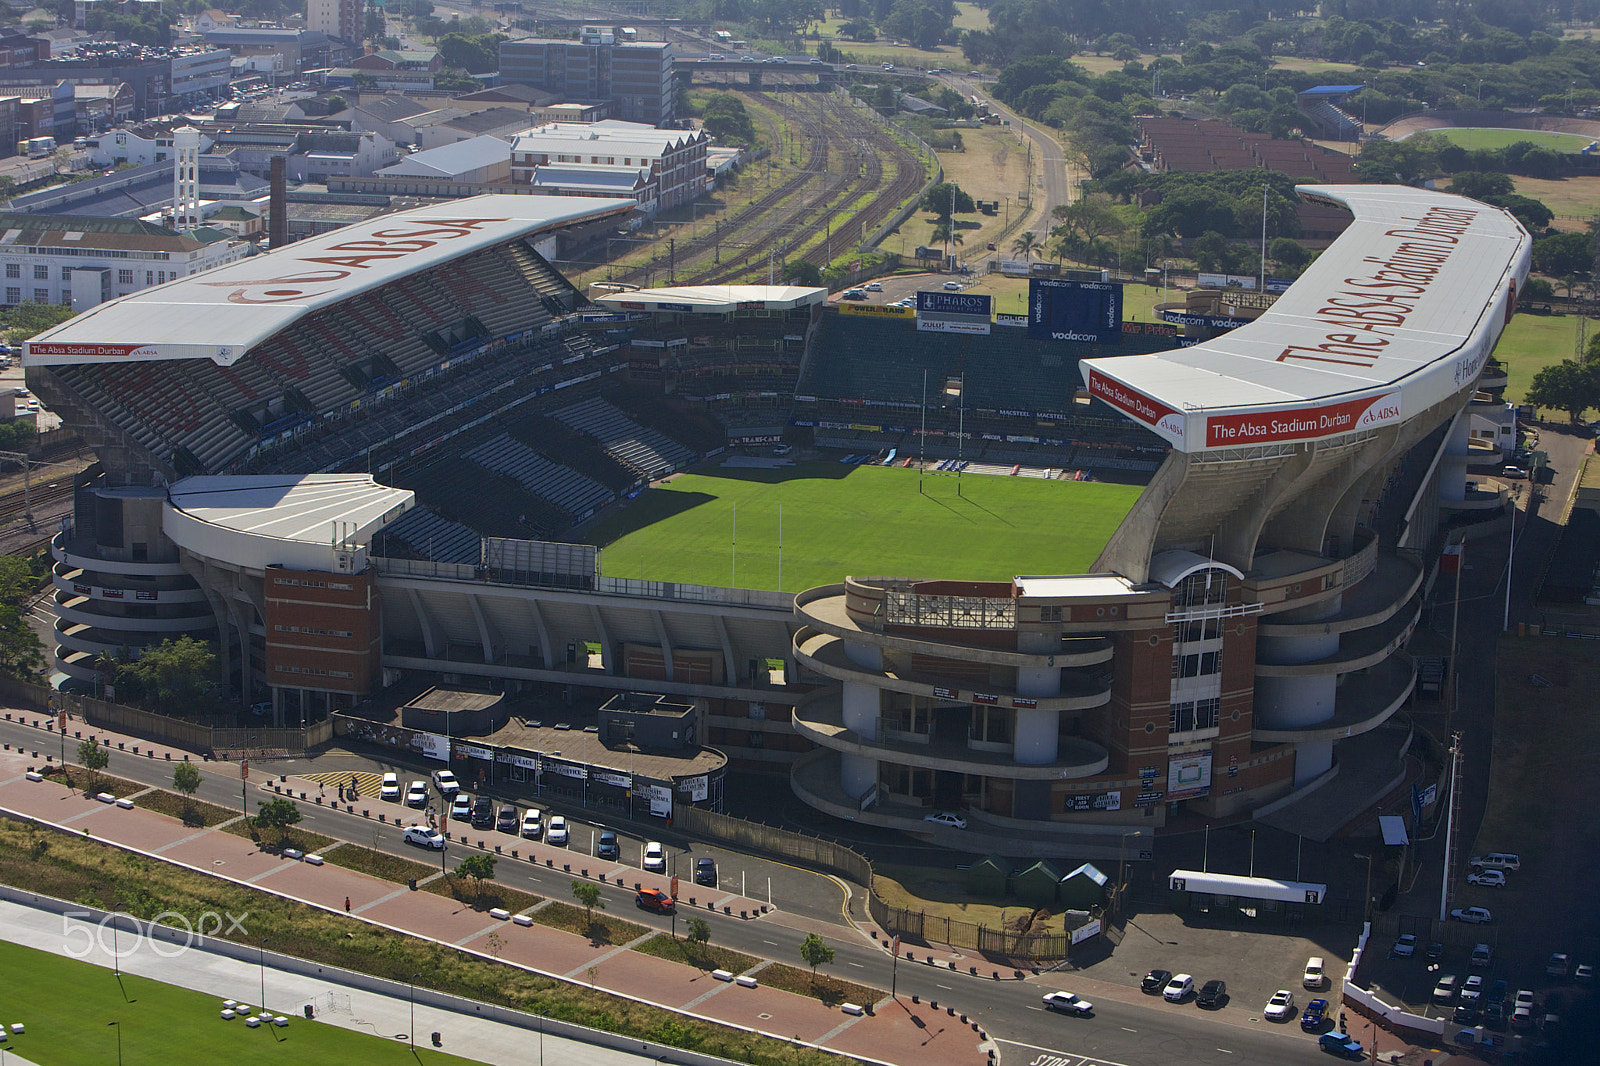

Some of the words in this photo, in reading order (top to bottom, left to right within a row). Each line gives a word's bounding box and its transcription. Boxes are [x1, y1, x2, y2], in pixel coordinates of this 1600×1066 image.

[1385, 207, 1479, 244] Durban
[296, 217, 511, 269] ABSA
[1344, 242, 1455, 293] Stadium
[1039, 279, 1072, 288] vodacom
[1080, 282, 1112, 291] vodacom
[937, 295, 983, 307] PHAROS
[848, 304, 876, 312] POWER
[1312, 291, 1420, 336] ABSA
[997, 314, 1029, 323] POLICE
[1165, 313, 1205, 326] vodacom
[1212, 317, 1247, 329] vodaco
[1052, 330, 1097, 342] vodacom
[1122, 323, 1141, 334] Mr
[1145, 325, 1176, 337] Price
[32, 345, 47, 354] The
[48, 346, 65, 354] Absa
[67, 346, 96, 355] Stadium
[98, 346, 125, 355] Durban
[1276, 333, 1390, 367] The
[1091, 377, 1101, 390] The
[1101, 381, 1114, 396] Absa
[1114, 385, 1135, 407] Stadium
[1135, 397, 1157, 419] Durban
[1376, 406, 1400, 422] ABSA
[1169, 424, 1184, 437] ABSA
[1212, 424, 1236, 439] The
[1238, 422, 1267, 437] Absa
[1271, 416, 1317, 434] Stadium
[1320, 413, 1351, 428] Durban
[1047, 655, 1054, 667] 3
